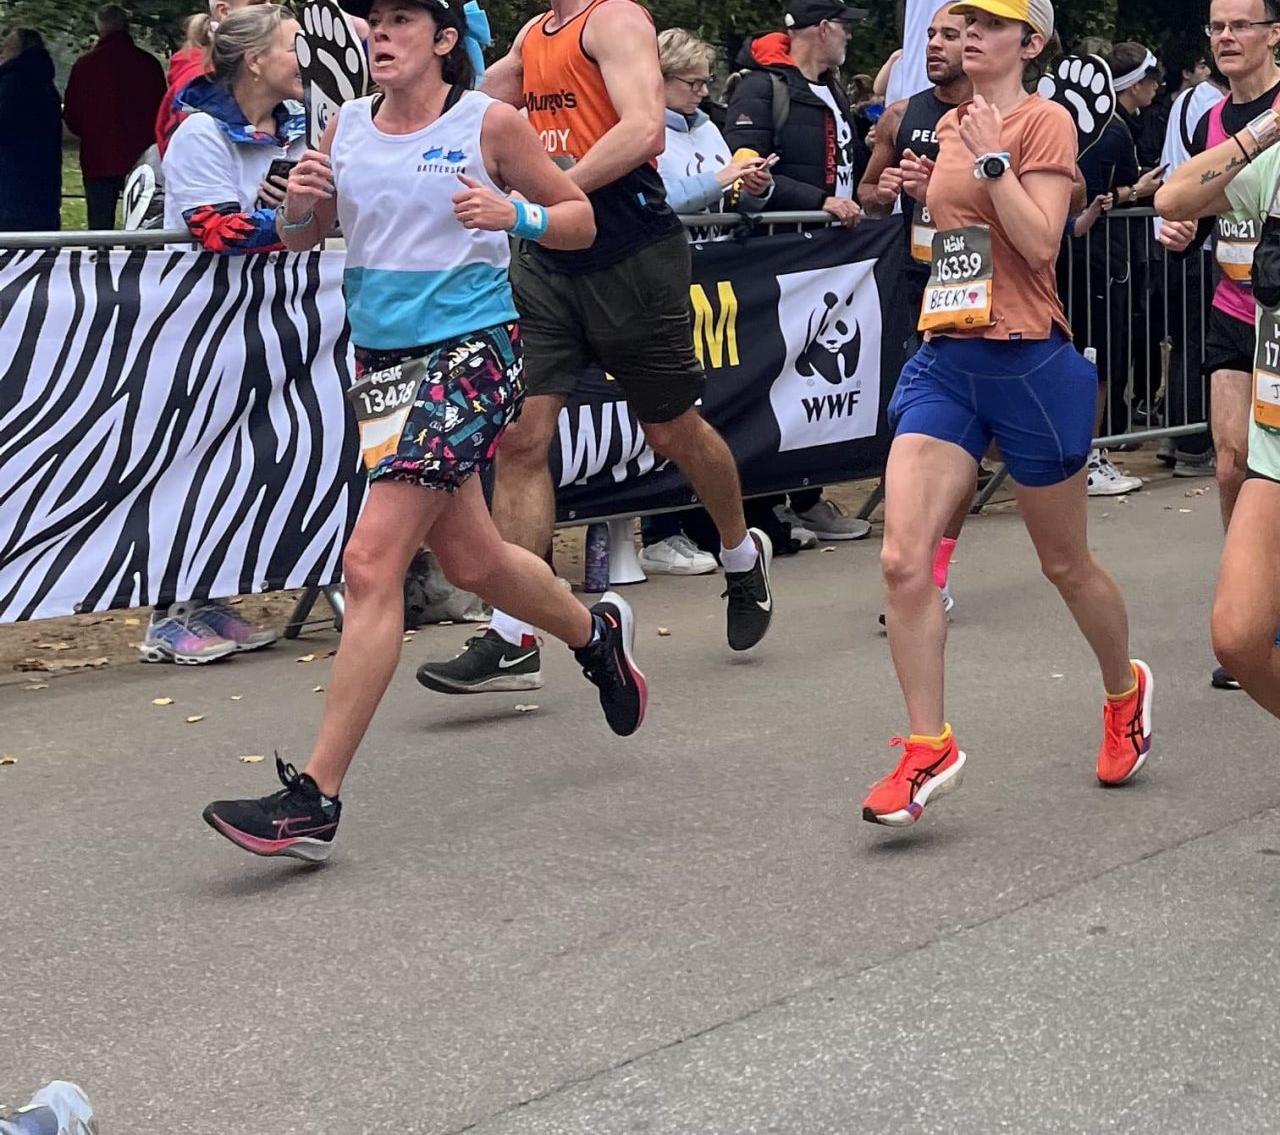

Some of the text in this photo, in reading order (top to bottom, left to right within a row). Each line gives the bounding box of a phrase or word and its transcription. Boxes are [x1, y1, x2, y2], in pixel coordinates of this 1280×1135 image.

[1218, 217, 1256, 239] 10421
[936, 252, 982, 282] 16339
[930, 286, 968, 311] BECKY
[801, 389, 861, 424] WWF
